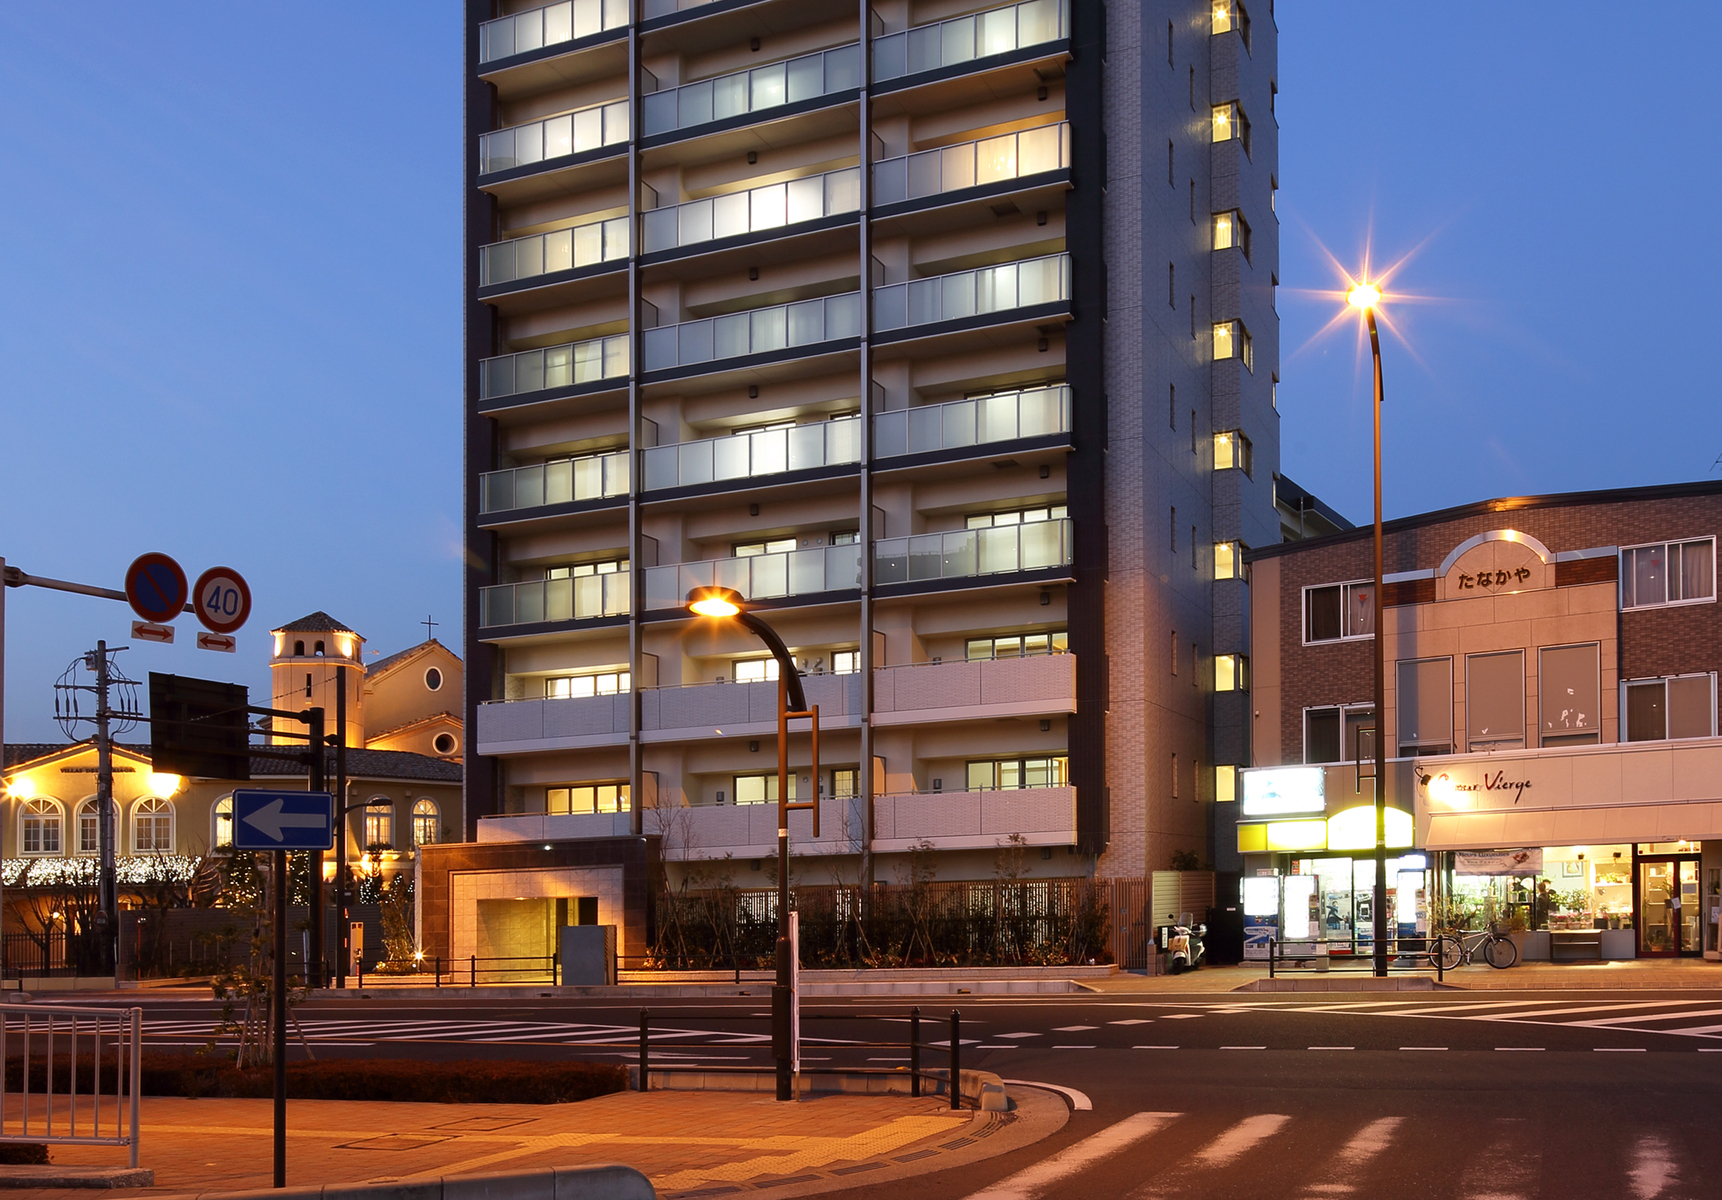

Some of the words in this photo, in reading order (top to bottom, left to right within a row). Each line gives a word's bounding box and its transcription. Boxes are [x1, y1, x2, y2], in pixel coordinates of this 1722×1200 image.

[1458, 567, 1531, 590] たなかや
[206, 585, 239, 616] 40
[1484, 770, 1532, 805] Vierge
